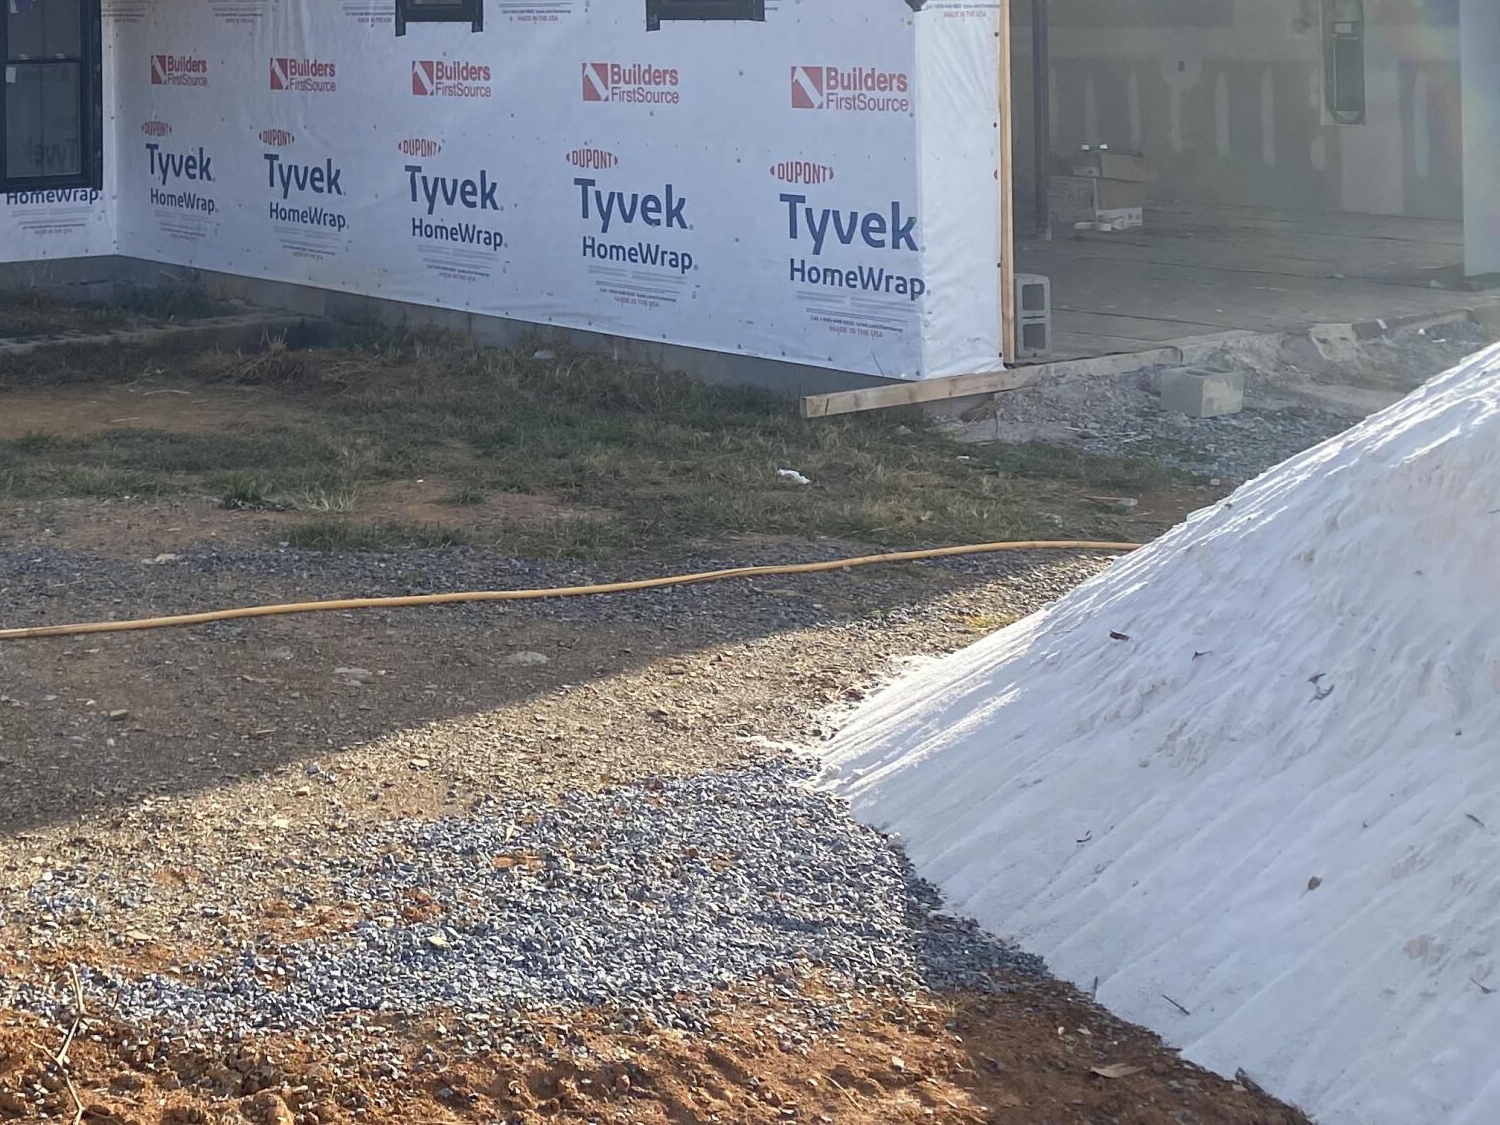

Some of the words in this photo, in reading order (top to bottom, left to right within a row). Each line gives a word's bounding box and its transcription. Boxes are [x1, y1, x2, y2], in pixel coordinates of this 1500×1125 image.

[167, 55, 207, 73] Builders
[289, 59, 336, 77] Builders
[435, 61, 491, 81] Builders
[610, 63, 679, 86] Builders
[167, 73, 208, 87] FirstSource
[289, 78, 336, 92] FirstSource
[435, 82, 492, 98] FirstSource
[826, 67, 908, 92] Builders
[611, 87, 680, 104] FirstSource
[826, 93, 909, 113] FirstSource
[144, 121, 169, 137] DUPONT
[262, 129, 292, 146] DUPONT
[403, 138, 438, 156] DUPONT
[146, 142, 212, 185] Tyvek
[572, 149, 613, 169] DUPONT
[263, 153, 343, 199] Tyvek
[777, 162, 828, 184] DUPONT
[6, 188, 99, 205] HomeWrap
[404, 165, 499, 215] Tyvek
[150, 188, 215, 216] HomeWrap
[574, 178, 689, 233] Tyvek
[269, 201, 346, 232] HomeWrap
[779, 193, 919, 255] Tyvek
[412, 217, 503, 251] HomeWrap
[583, 236, 693, 274] HomeWrap
[789, 258, 925, 301] HomeWrap
